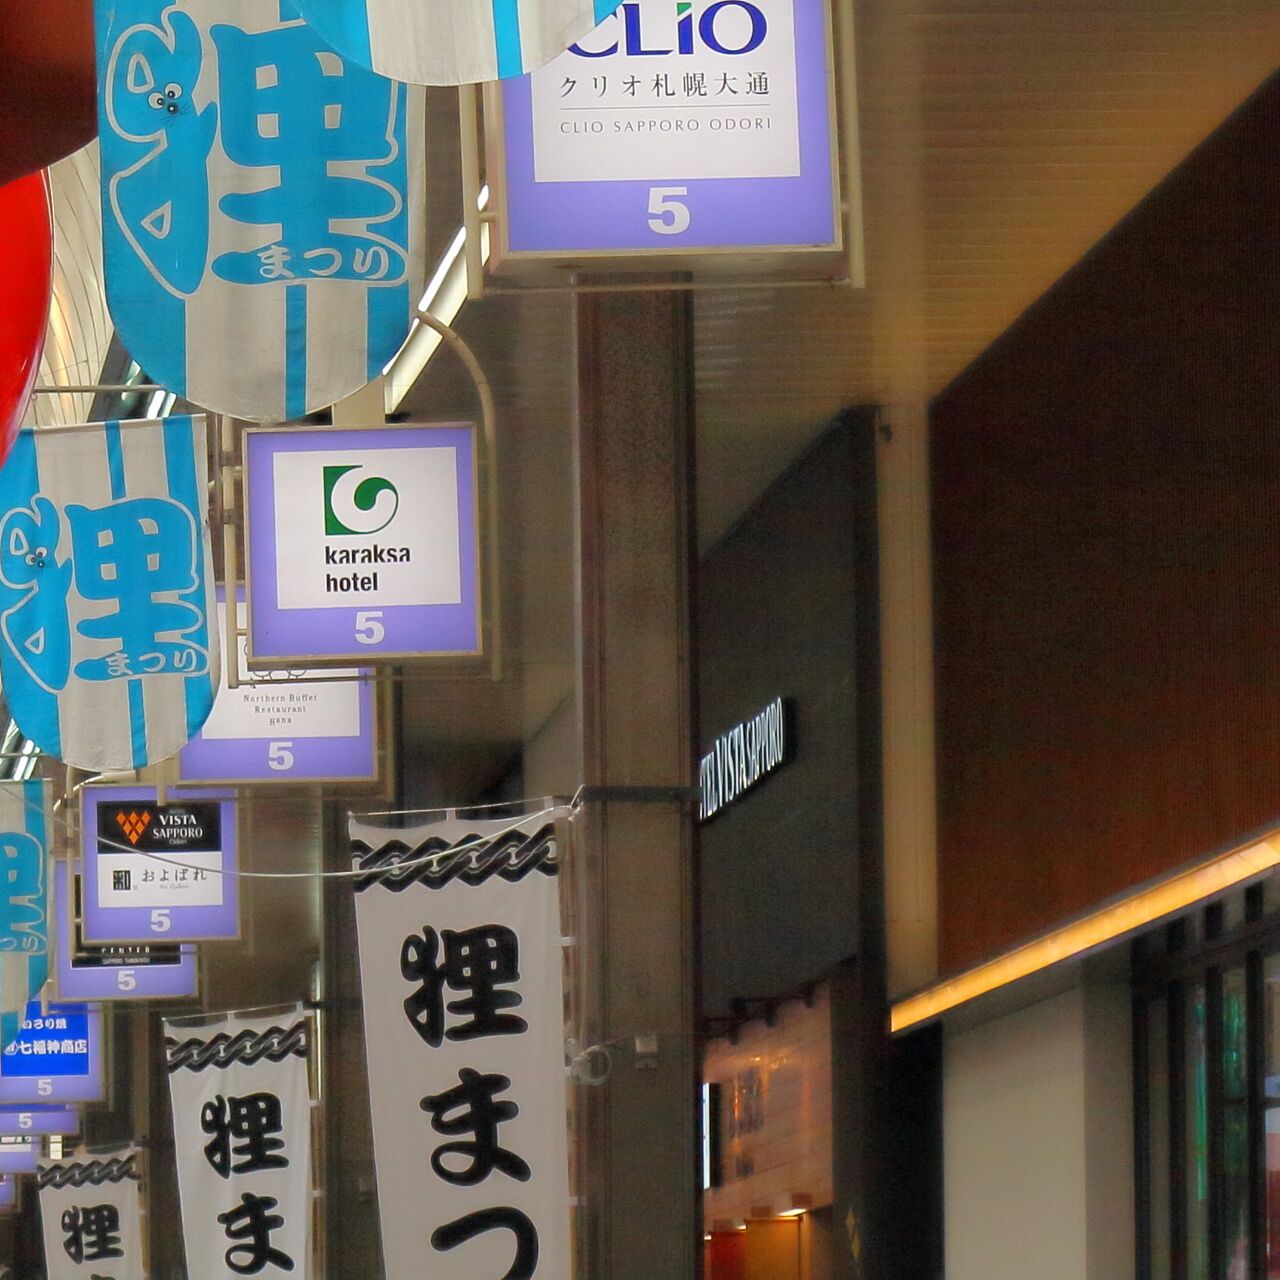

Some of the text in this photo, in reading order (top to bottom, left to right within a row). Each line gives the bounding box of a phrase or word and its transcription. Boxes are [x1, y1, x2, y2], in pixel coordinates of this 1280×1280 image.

[560, 72, 770, 97] クリオ札幌大通
[560, 118, 771, 134] CLIO SAPPORO ODORI
[647, 187, 691, 235] 5
[257, 245, 390, 279] まつり
[325, 545, 411, 565] karaksa
[326, 572, 378, 592] hotel
[355, 611, 385, 645] 5
[107, 649, 197, 676] まつり
[243, 694, 318, 703] Northern Buffet
[255, 706, 306, 714] Restaurant
[268, 742, 294, 770] 5
[159, 815, 197, 826] VISTA
[152, 827, 203, 838] SAPPORO
[142, 869, 208, 882] およばれ
[150, 909, 171, 932] 5
[117, 971, 136, 990] 5
[38, 1079, 53, 1096] 5
[19, 1113, 32, 1128] 5
[60, 1203, 125, 1280] 狸
